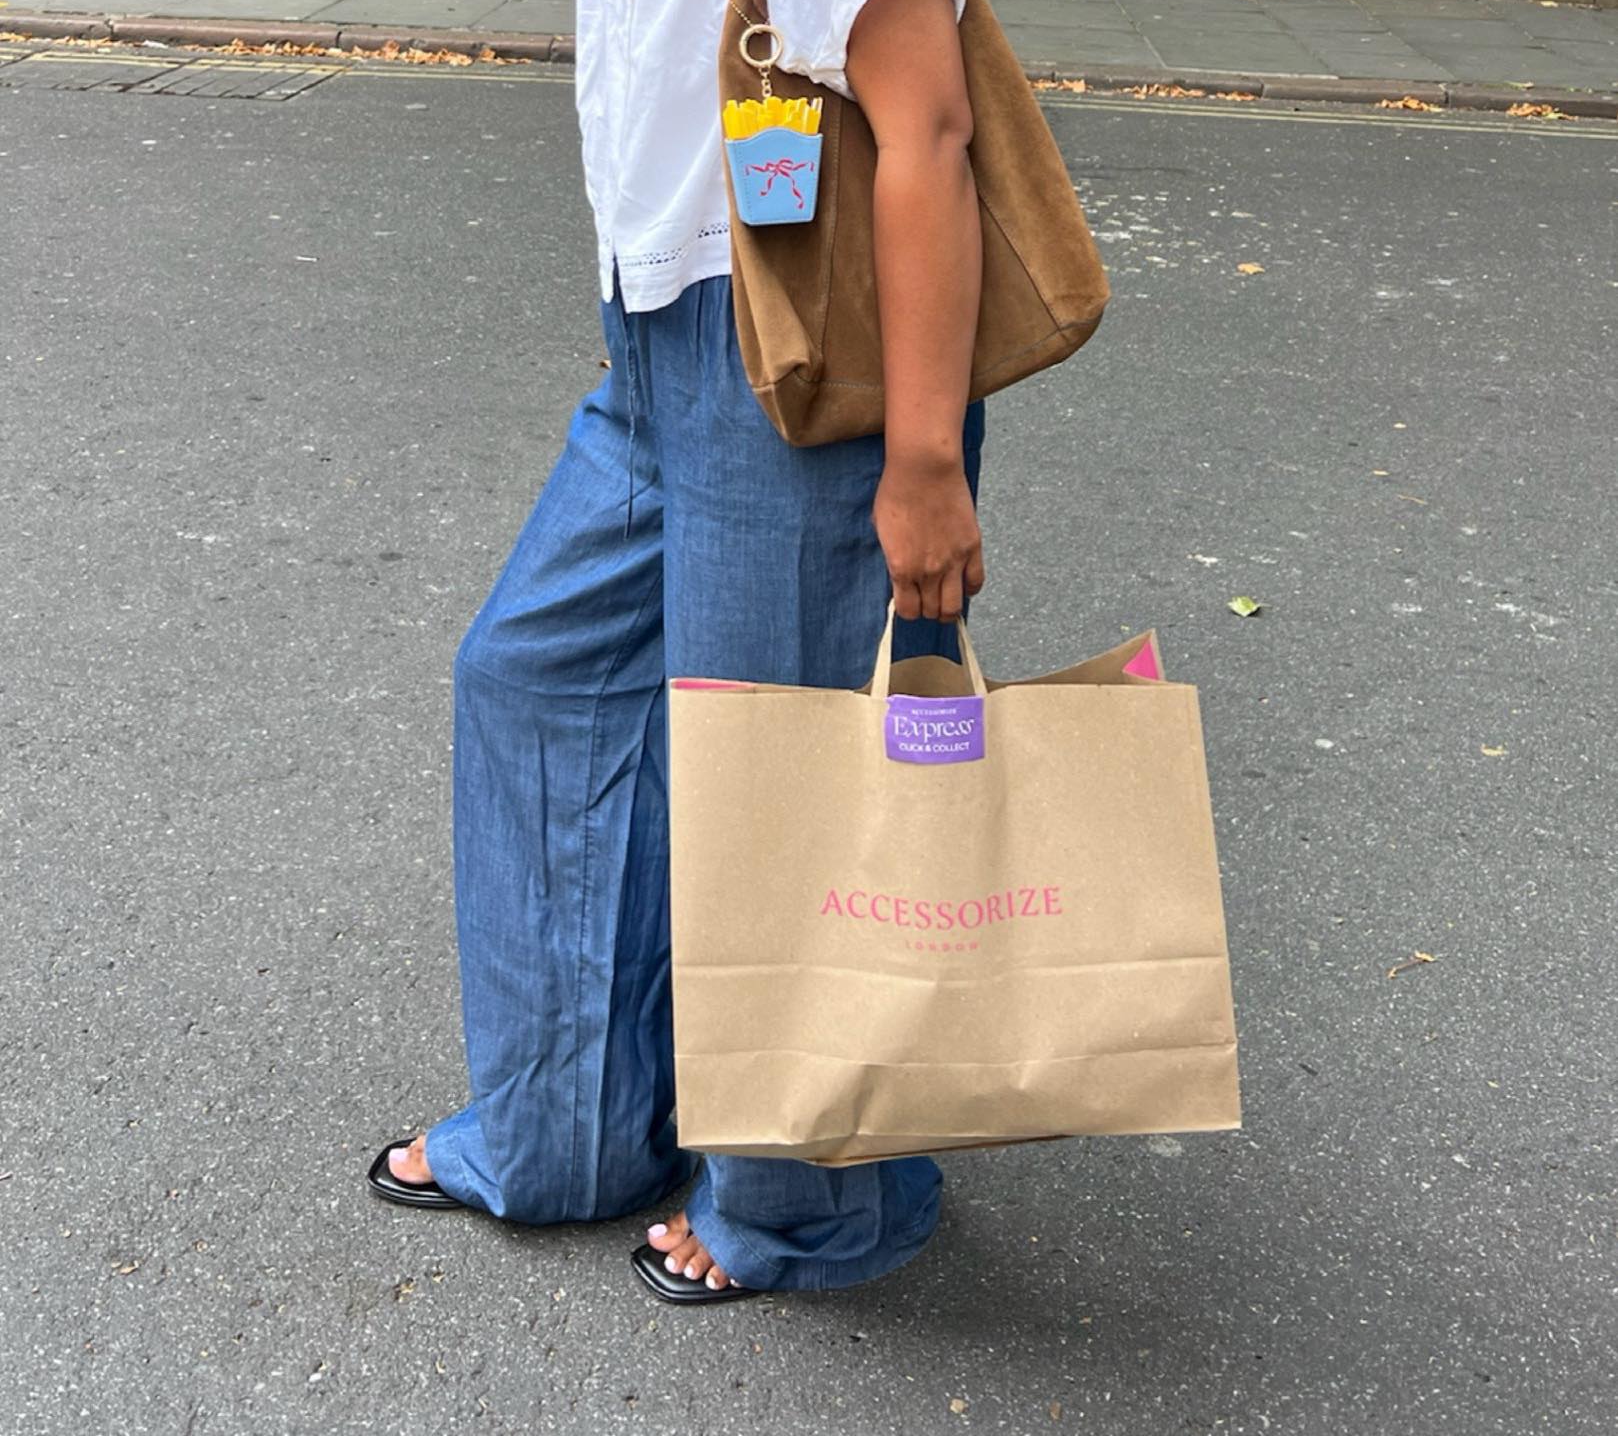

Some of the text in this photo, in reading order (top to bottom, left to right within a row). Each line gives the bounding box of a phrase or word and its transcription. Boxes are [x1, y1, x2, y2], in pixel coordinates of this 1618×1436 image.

[893, 715, 975, 743] Express
[898, 741, 970, 753] CLICK & COLLECT
[820, 886, 1063, 931] ACCESSORIZE
